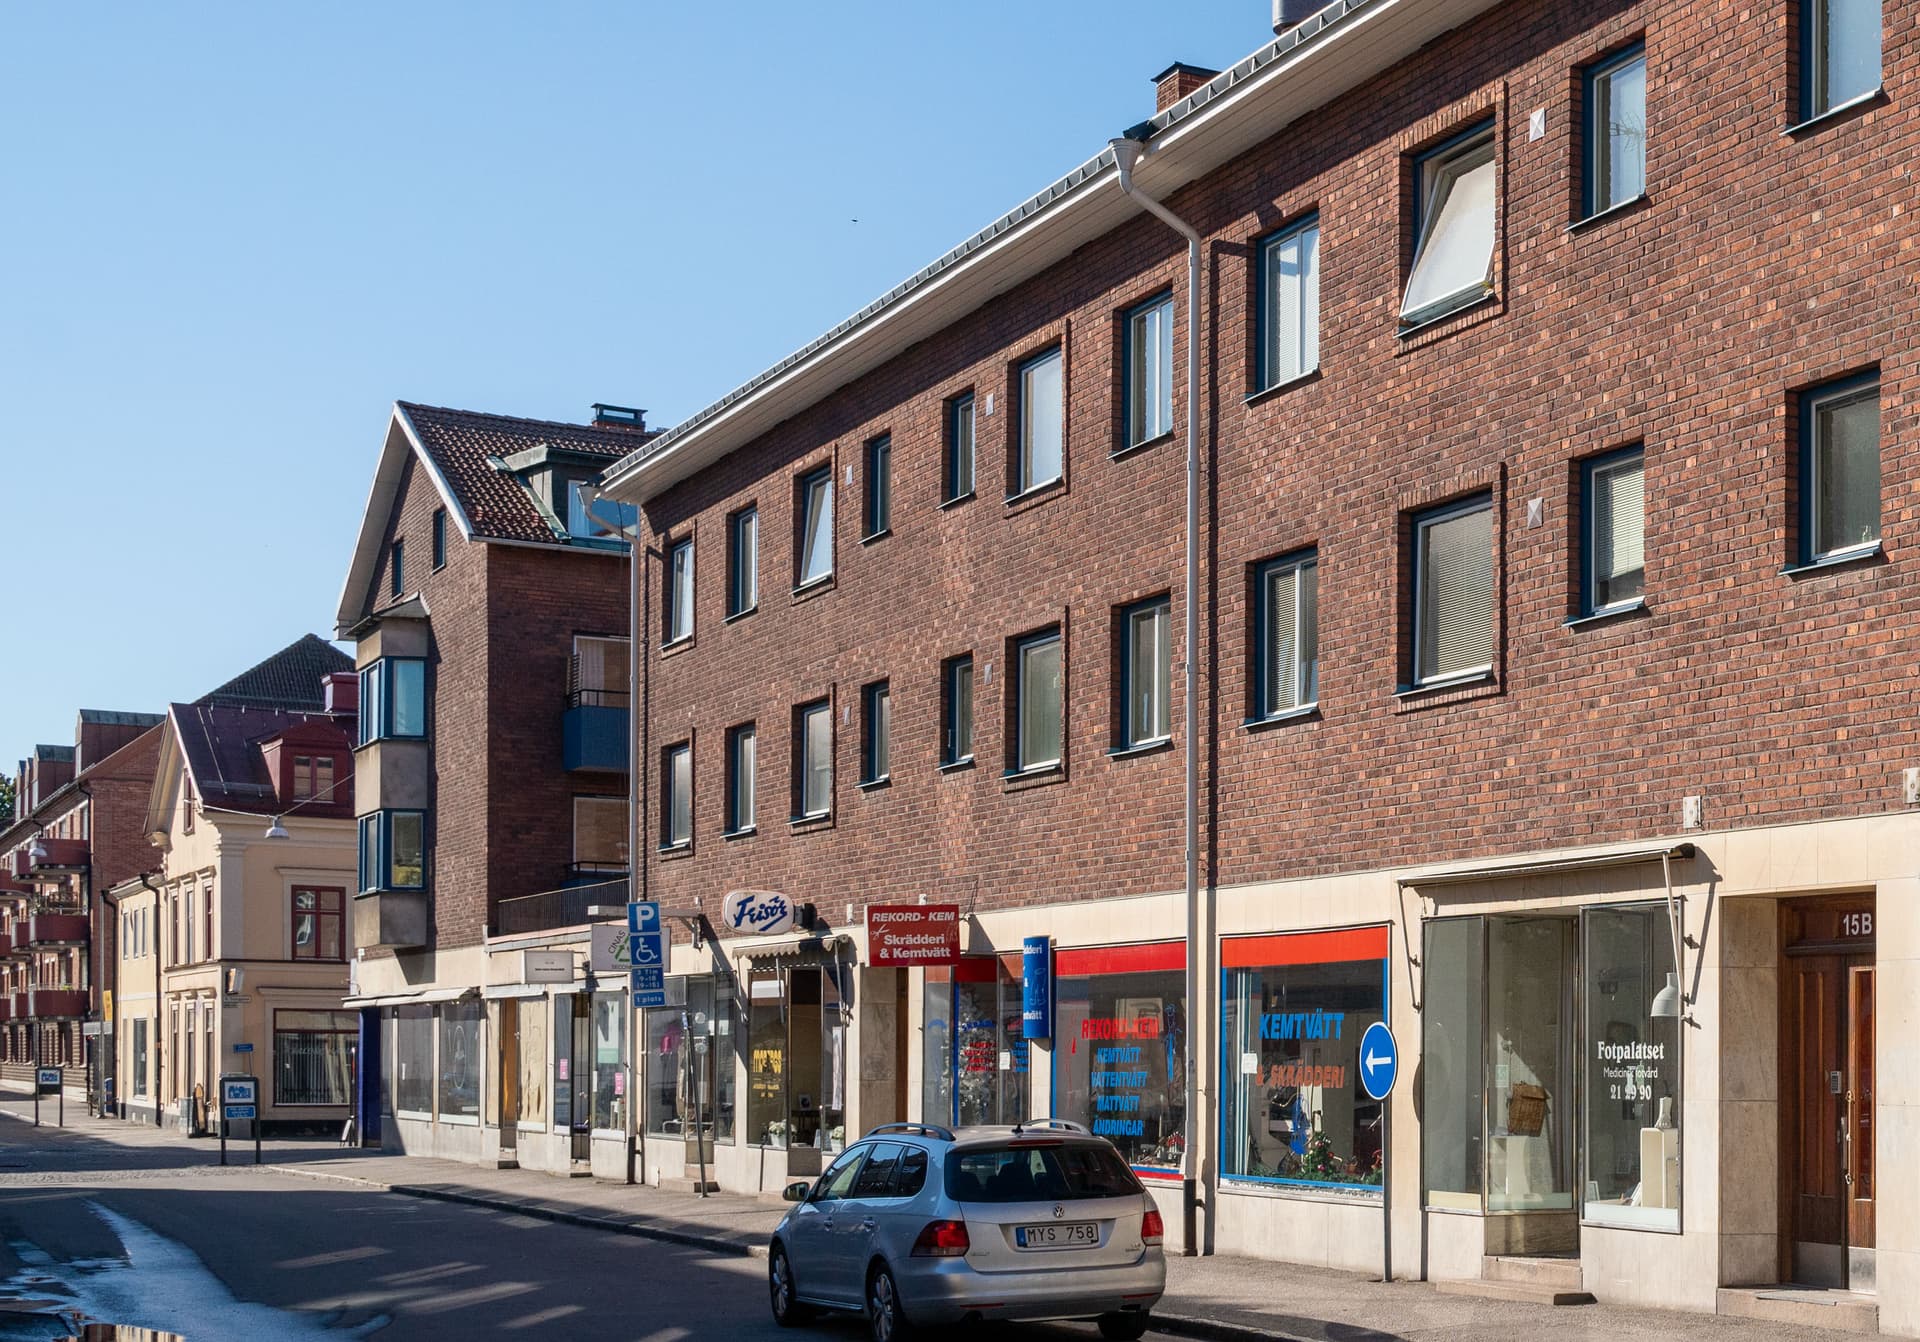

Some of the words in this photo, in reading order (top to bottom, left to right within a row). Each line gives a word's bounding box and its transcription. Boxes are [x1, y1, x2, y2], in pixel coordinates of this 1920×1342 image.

[635, 905, 654, 931] P
[733, 895, 788, 932] Frisör
[928, 911, 955, 921] KEM
[1843, 913, 1872, 936] 15B
[608, 929, 627, 954] CINAS
[884, 934, 945, 945] Skrädderi
[880, 948, 890, 959] &
[893, 947, 951, 958] Kemtvätt
[1081, 1018, 1159, 1039] REKORD-KEM
[1258, 1008, 1345, 1039] KEMTVÄTT
[1598, 1041, 1665, 1063] Fotpalatset
[1270, 1059, 1345, 1088] SKRÄDDERI
[1610, 1084, 1621, 1100] 21
[1640, 1084, 1652, 1101] 90
[1027, 1228, 1056, 1243] MYS
[1066, 1226, 1095, 1240] 758
